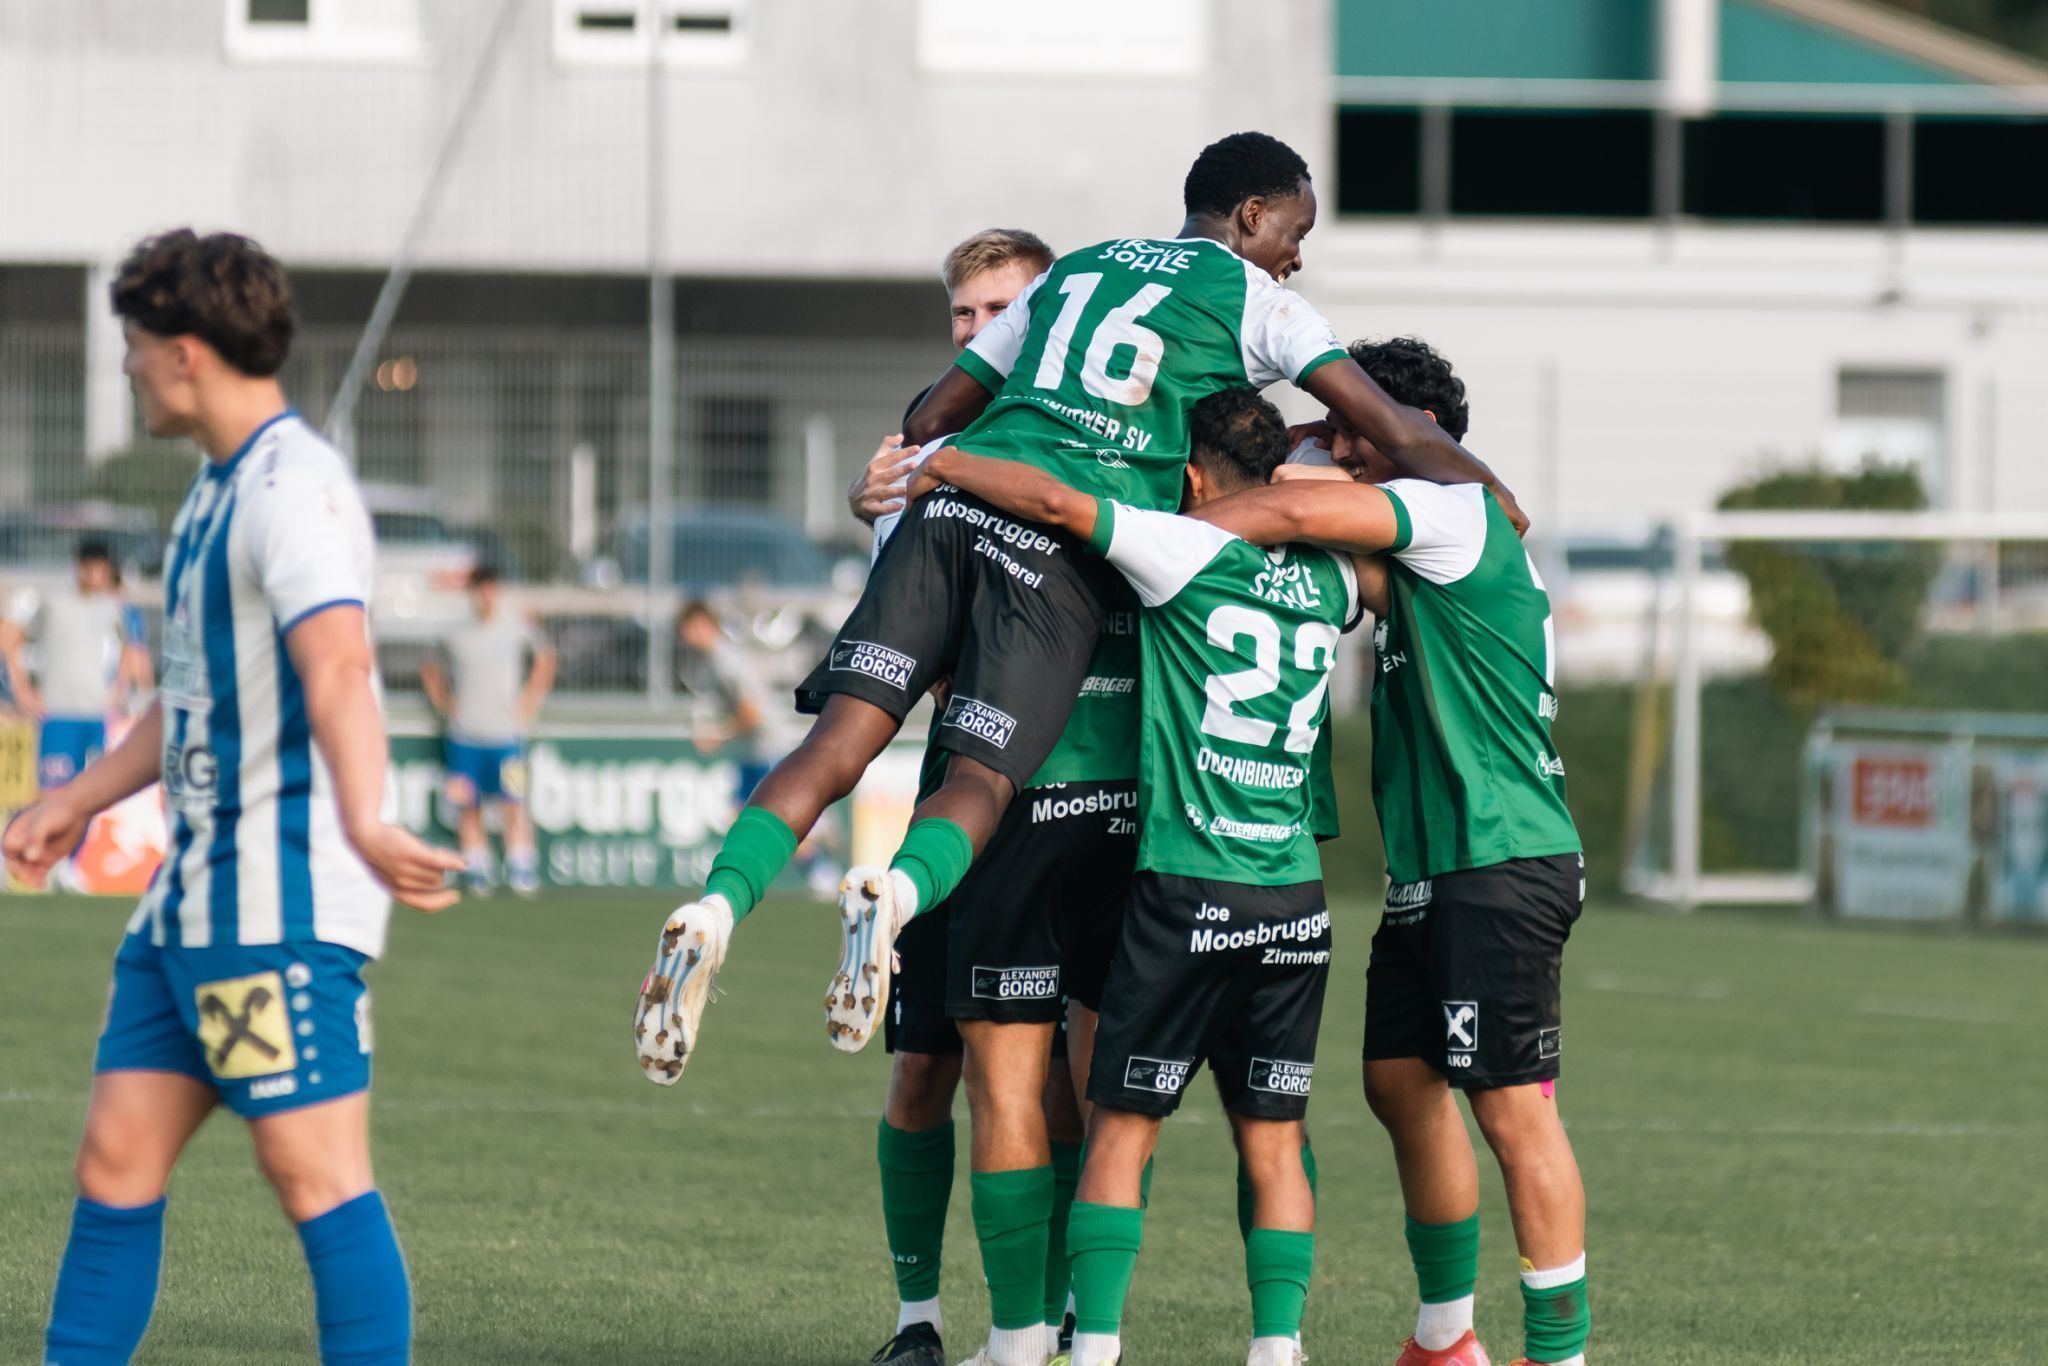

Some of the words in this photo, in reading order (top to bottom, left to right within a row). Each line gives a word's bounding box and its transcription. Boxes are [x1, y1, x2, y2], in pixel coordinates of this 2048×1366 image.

[1033, 272, 1173, 406] 16
[1122, 426, 1152, 452] SV
[850, 653, 906, 687] GORGA
[855, 644, 912, 671] ALEXANDER
[1200, 604, 1341, 754] 22
[956, 710, 1004, 744] GORGA
[964, 702, 1013, 730] ALEXANDER
[1195, 902, 1230, 921] Joe
[999, 980, 1055, 997] GORGA
[1000, 969, 1057, 981] ALEXANDER
